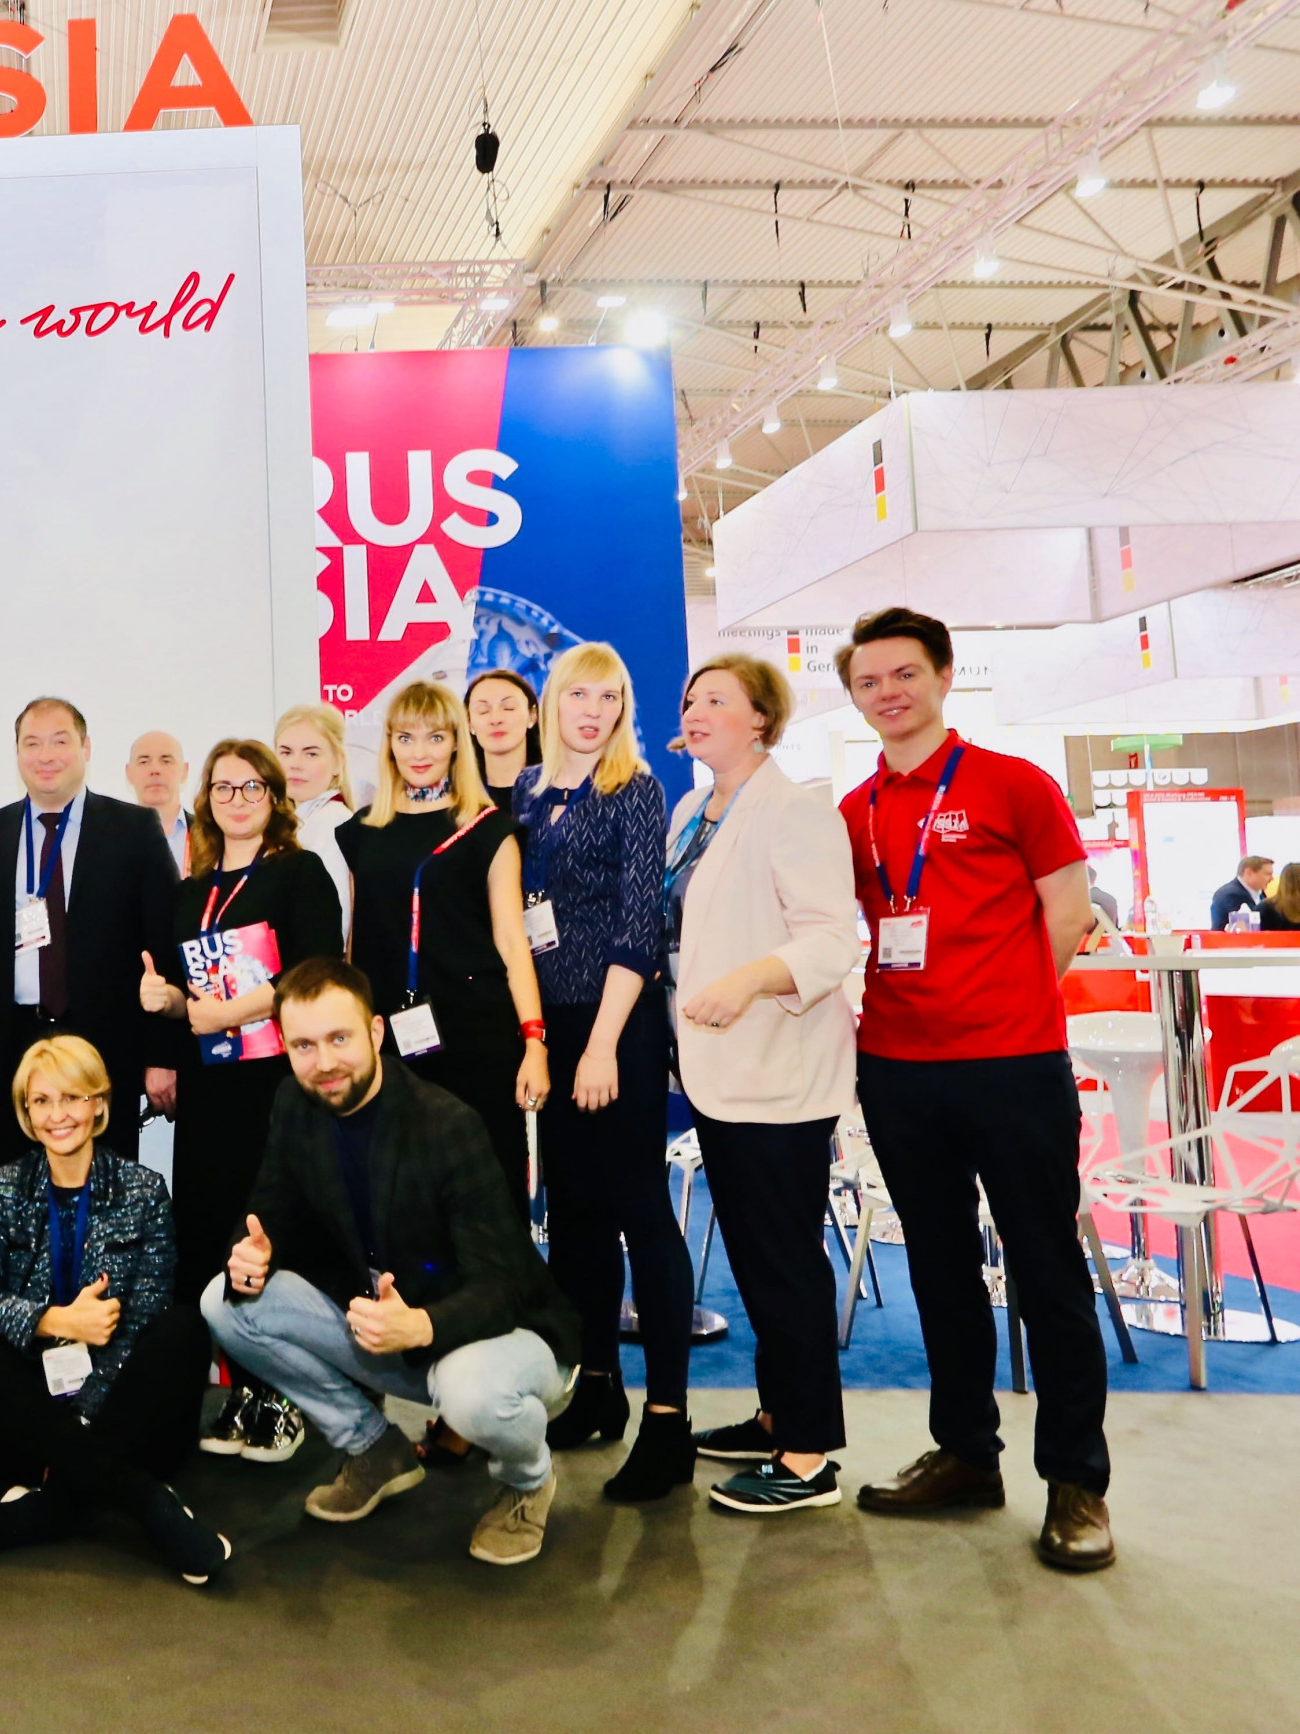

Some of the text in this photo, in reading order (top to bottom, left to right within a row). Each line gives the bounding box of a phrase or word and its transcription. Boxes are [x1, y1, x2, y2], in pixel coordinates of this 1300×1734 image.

[20, 271, 236, 339] world
[315, 543, 479, 643] IA
[806, 643, 819, 654] in
[322, 683, 355, 702] TO
[182, 928, 243, 967] RUS
